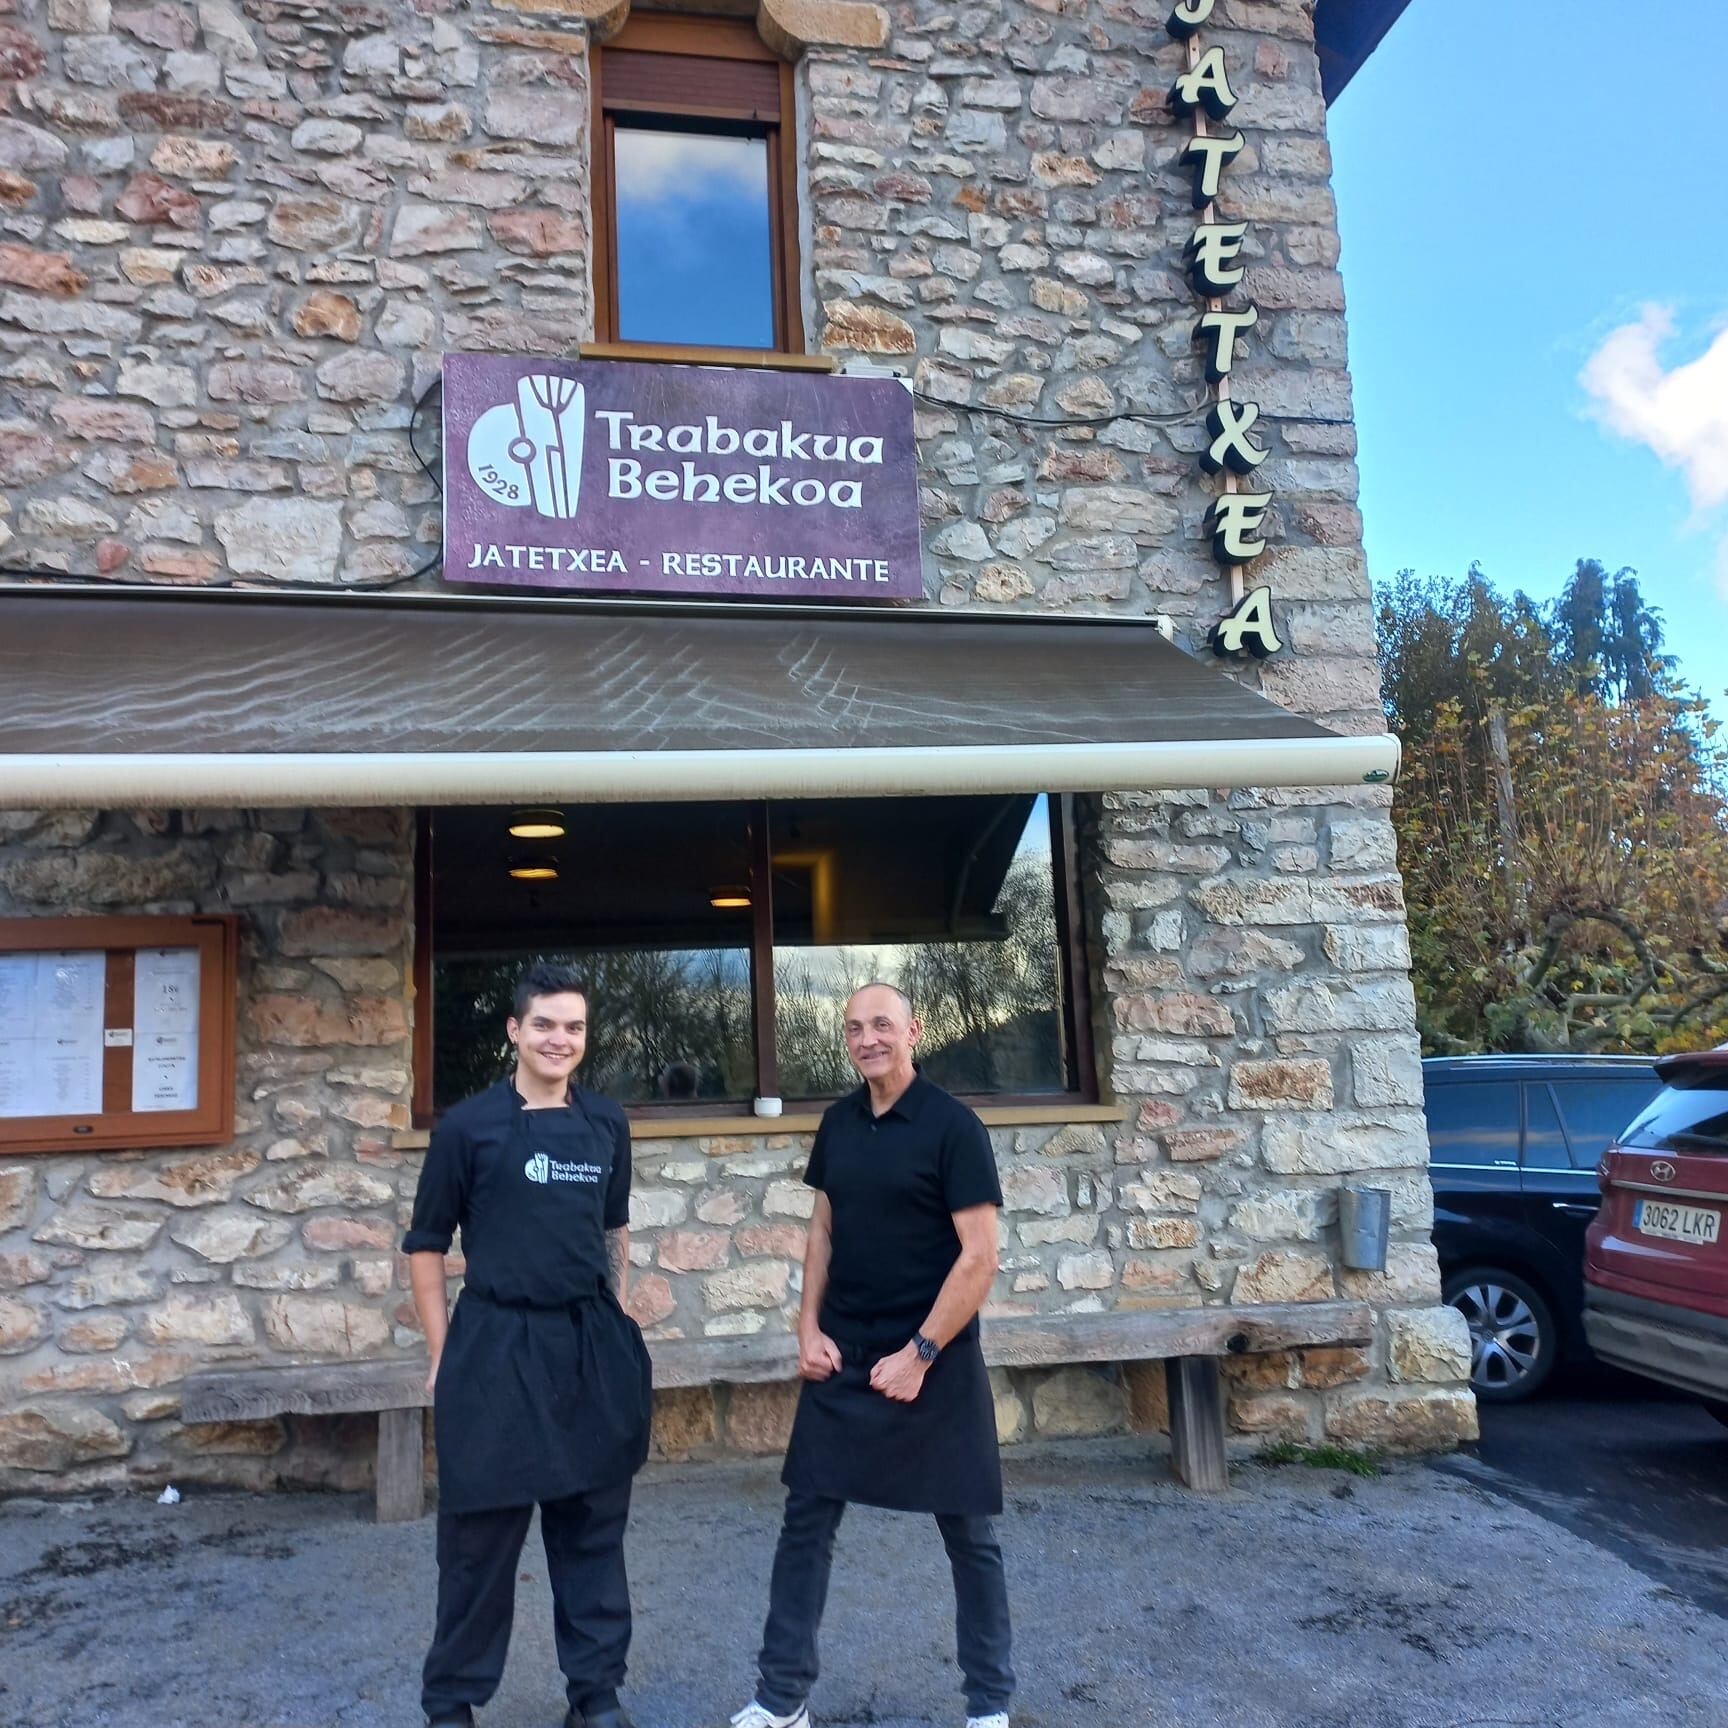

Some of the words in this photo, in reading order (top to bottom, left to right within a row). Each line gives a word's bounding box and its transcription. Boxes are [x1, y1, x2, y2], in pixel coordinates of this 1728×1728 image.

[478, 463, 519, 500] 1928
[607, 458, 864, 508] Behekoa
[467, 543, 628, 574] JATETXEA
[639, 558, 650, 567] -
[661, 552, 890, 582] RESTAURANTE
[1643, 1205, 1678, 1231] 3062
[1682, 1210, 1715, 1238] LKR
